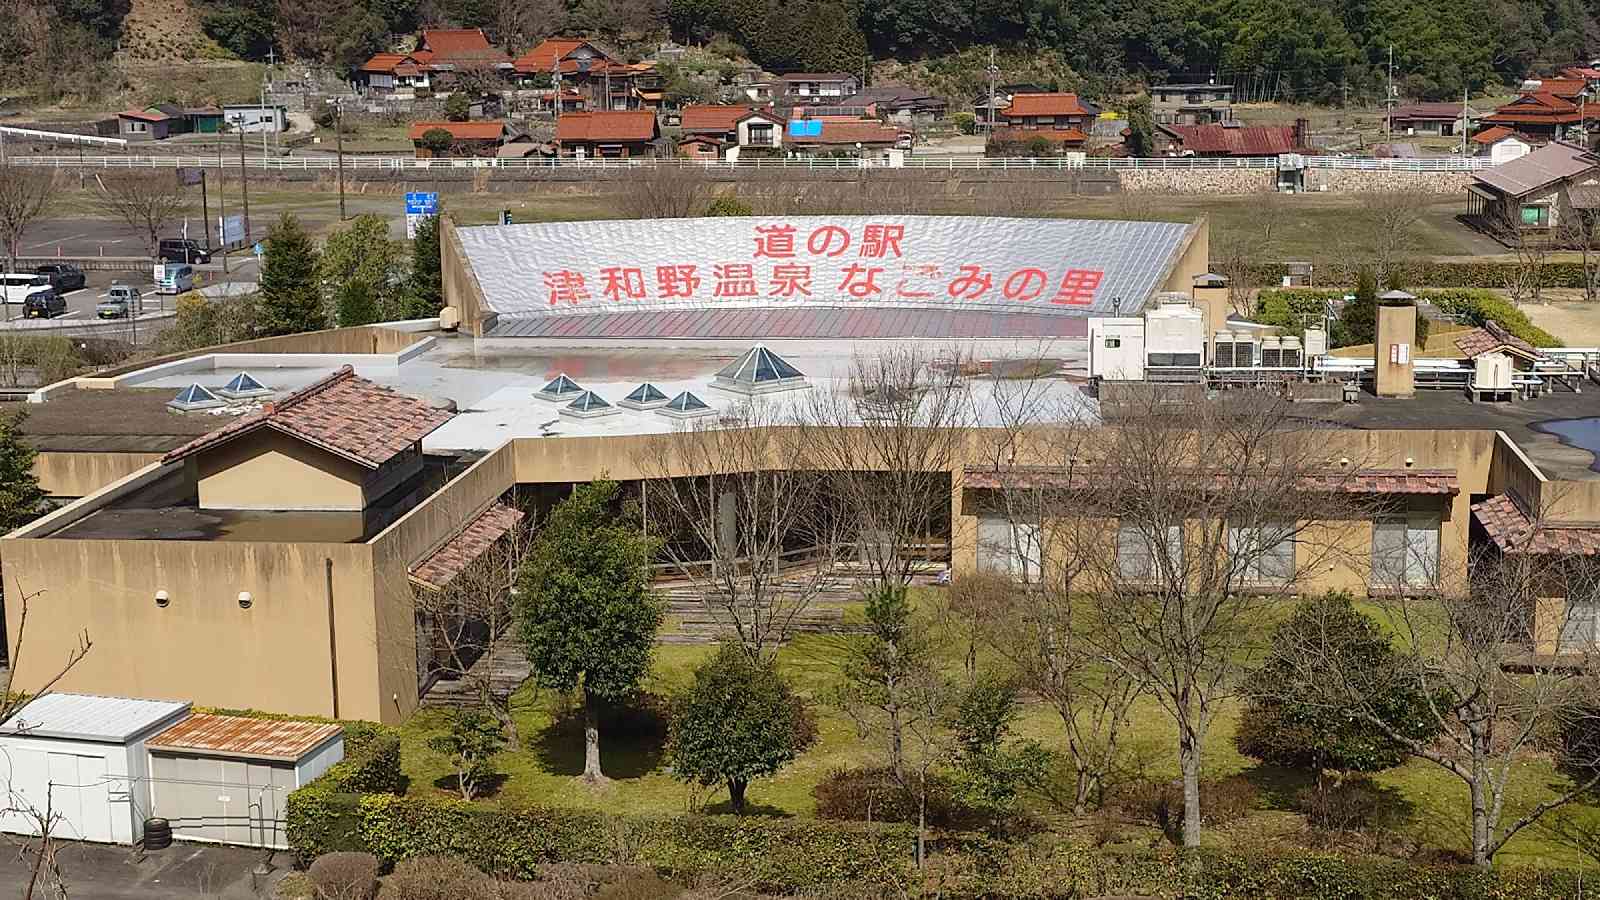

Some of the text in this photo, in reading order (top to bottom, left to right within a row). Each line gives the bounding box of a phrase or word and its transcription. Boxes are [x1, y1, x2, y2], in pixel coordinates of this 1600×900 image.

[753, 223, 905, 259] 道の駅
[543, 263, 812, 305] 津和野温泉
